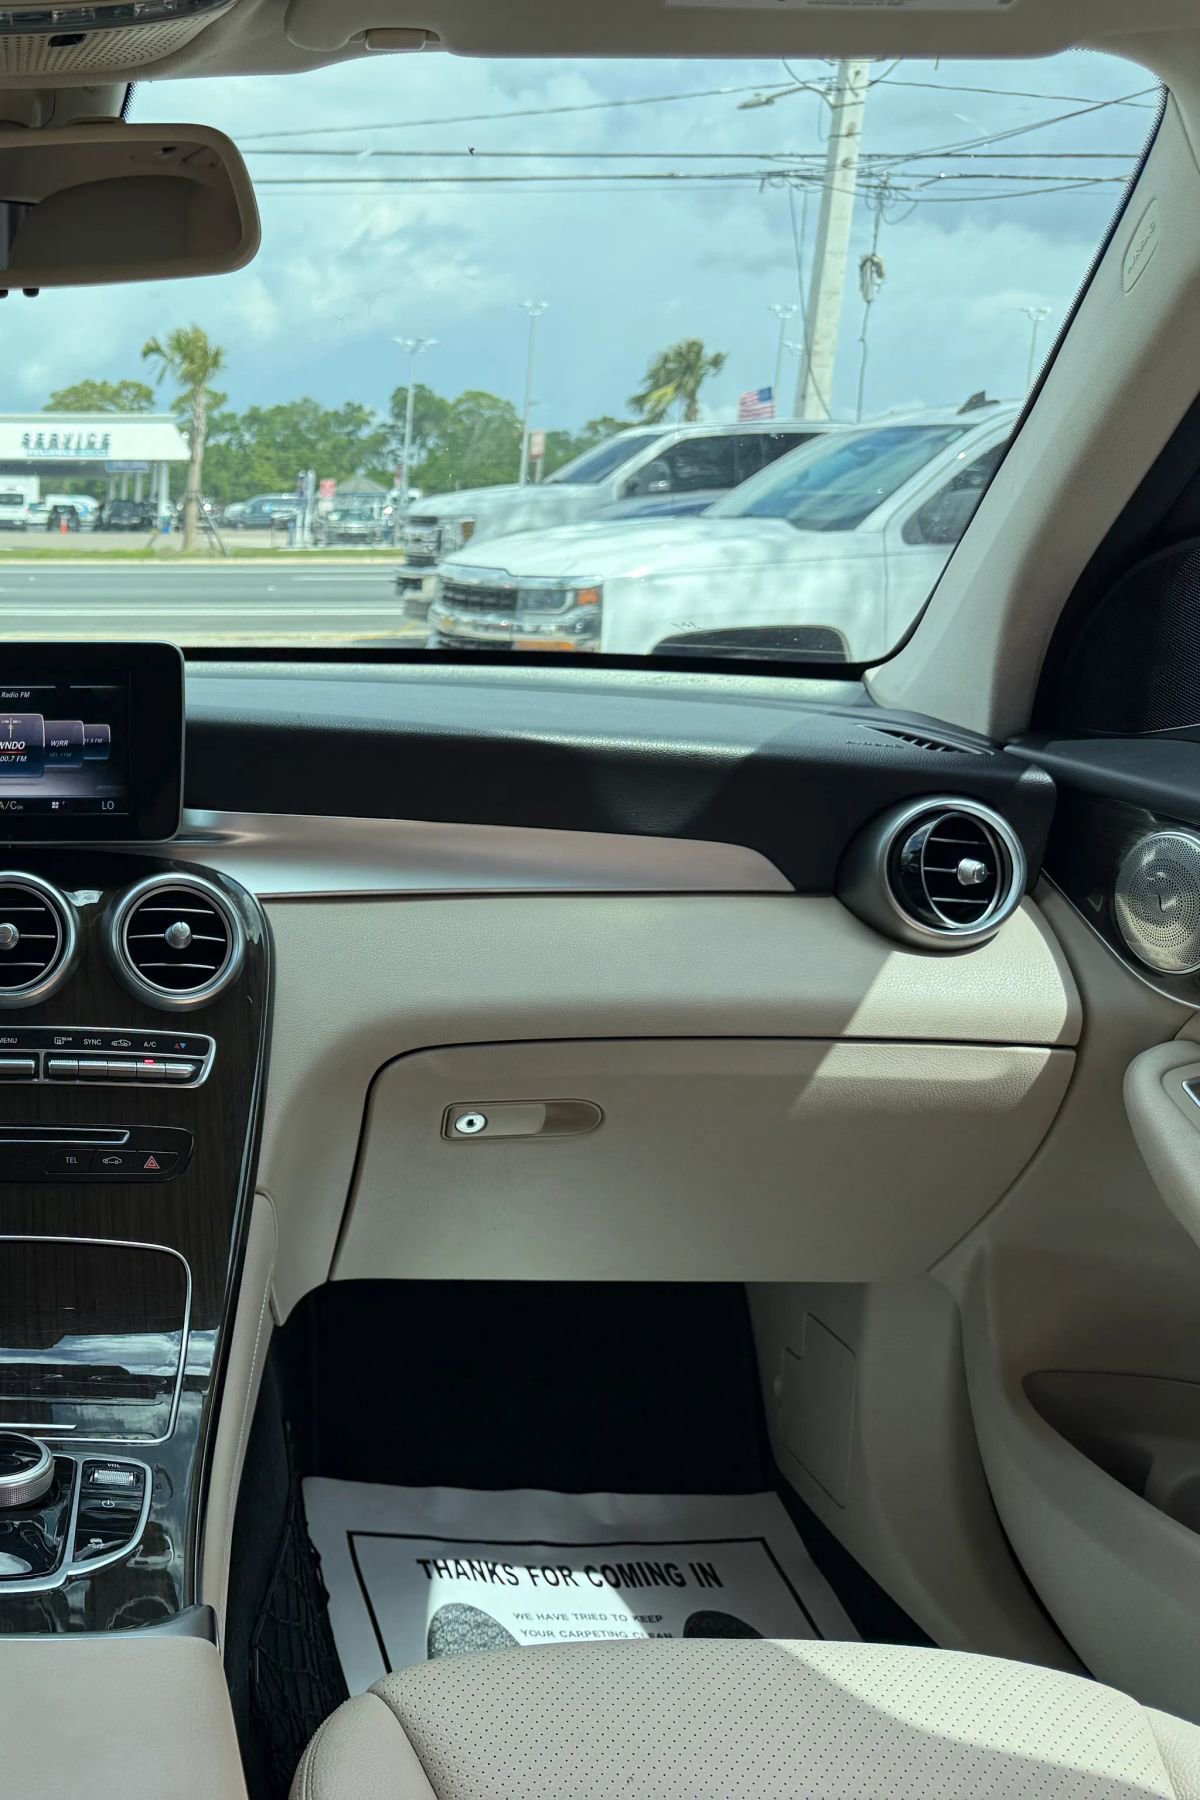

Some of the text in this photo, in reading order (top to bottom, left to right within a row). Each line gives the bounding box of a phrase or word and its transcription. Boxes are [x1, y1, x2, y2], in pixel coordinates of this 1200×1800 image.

[22, 432, 112, 449] SERVICE
[50, 739, 69, 747] WJRR
[16, 755, 28, 763] FM
[101, 801, 115, 810] LO
[83, 1038, 102, 1046] SYNC
[65, 1156, 78, 1164] TEL
[416, 1557, 725, 1589] THANKS FOR COMING IN
[512, 1612, 664, 1624] WE HAVE TRIED TO KEEP
[520, 1629, 555, 1638] YOUR
[559, 1630, 629, 1639] CARPETING
